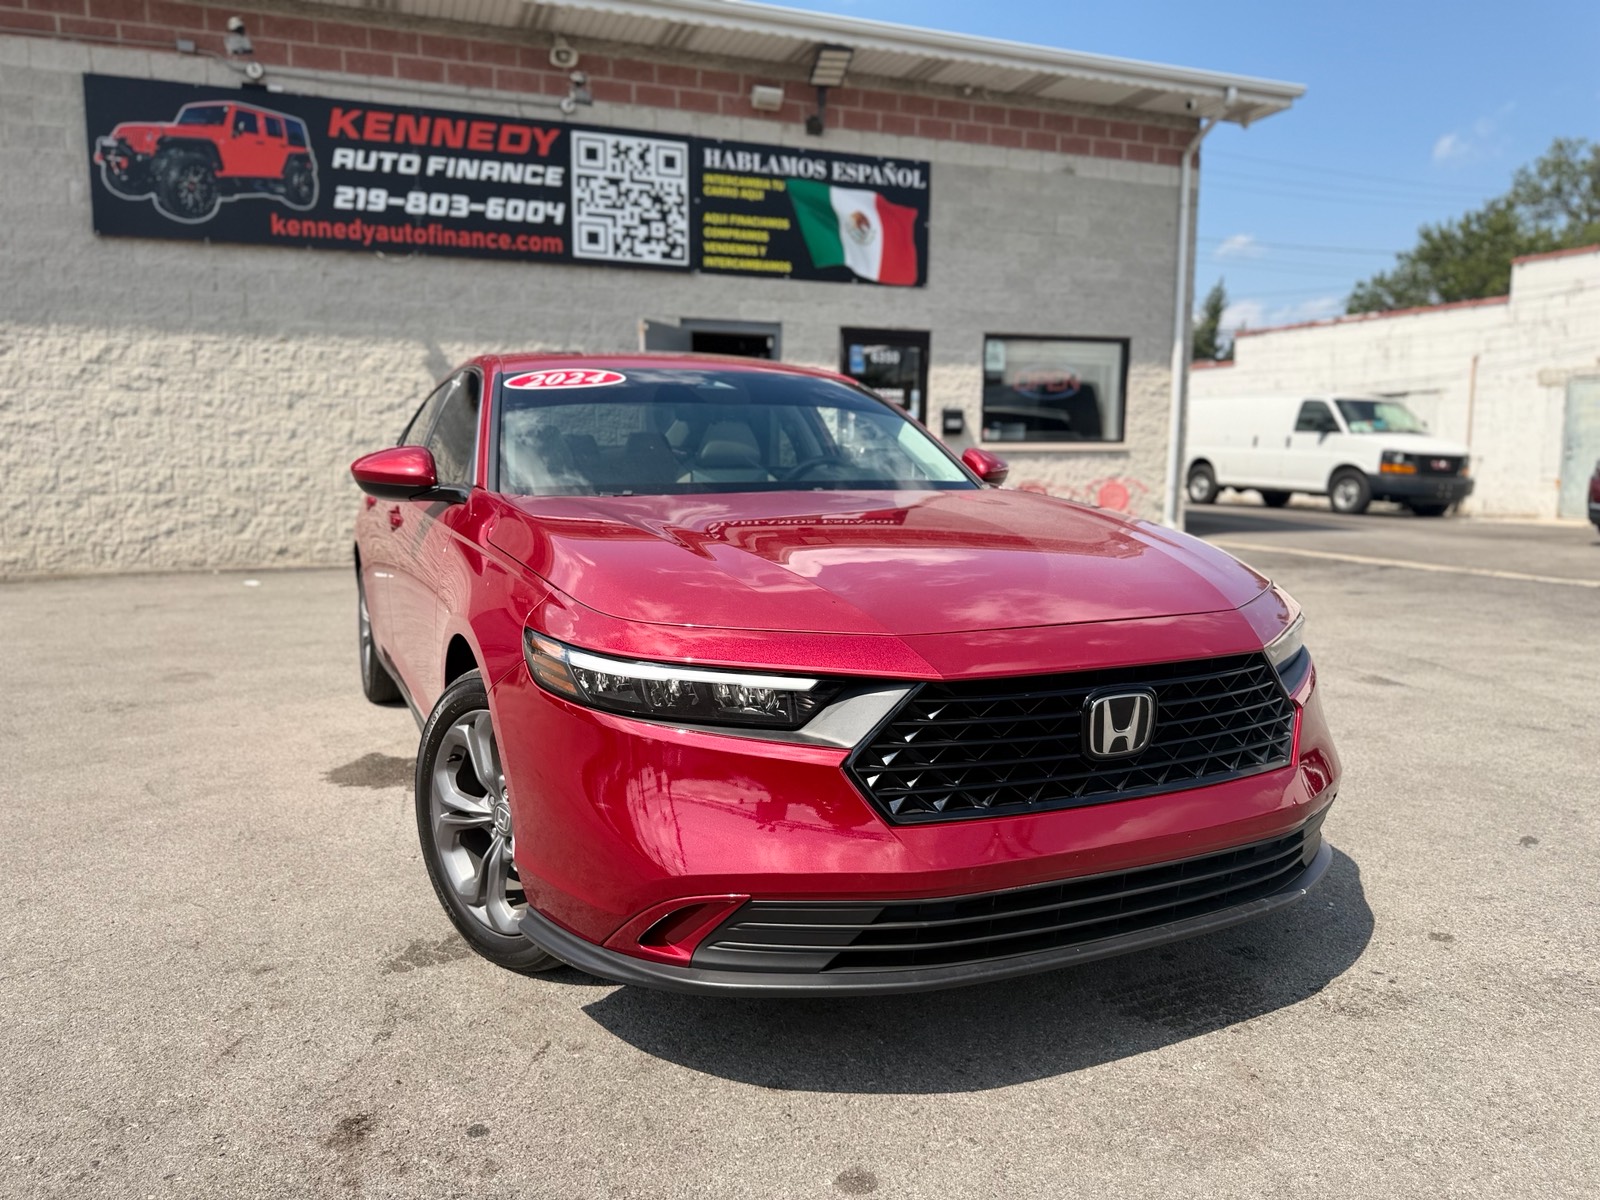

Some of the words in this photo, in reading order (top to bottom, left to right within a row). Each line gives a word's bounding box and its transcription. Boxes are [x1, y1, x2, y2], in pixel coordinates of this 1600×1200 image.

[328, 107, 560, 157] KENNEDY
[331, 147, 421, 176] AUTO
[426, 155, 565, 187] FINANCE
[703, 147, 827, 180] HABLAMOS
[832, 161, 928, 190] ESPAÑOL
[333, 185, 566, 225] 219-803-6004
[270, 212, 564, 254] kennedyautofinance.com
[703, 226, 770, 243] COMPRAMOS
[523, 372, 609, 388] 2024
